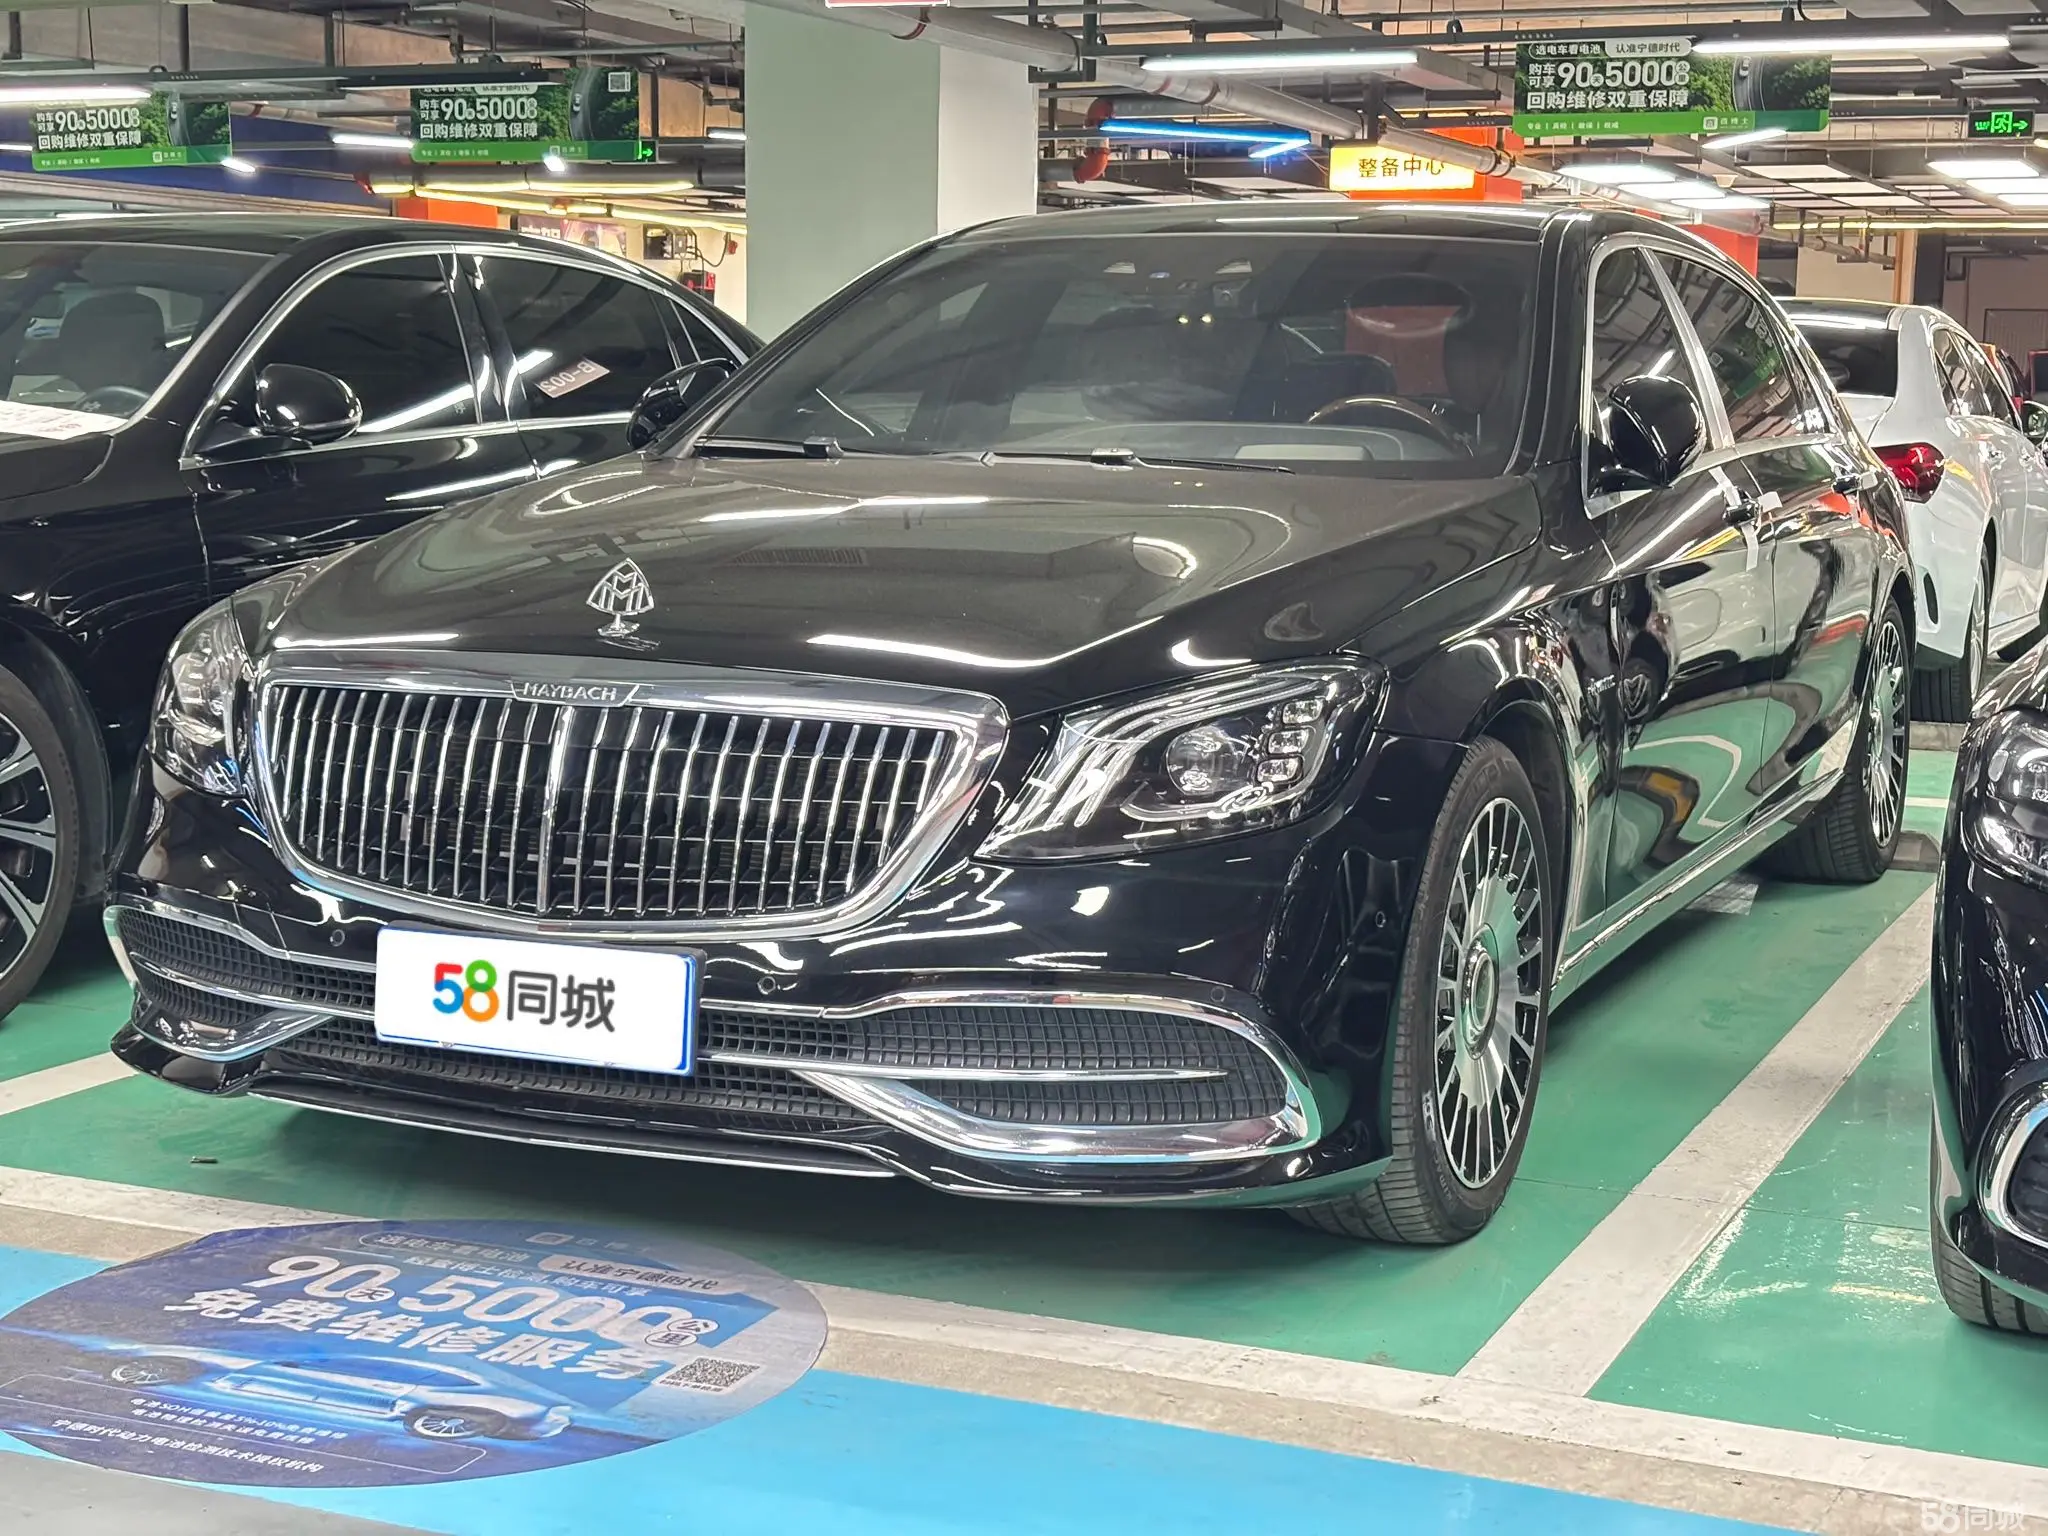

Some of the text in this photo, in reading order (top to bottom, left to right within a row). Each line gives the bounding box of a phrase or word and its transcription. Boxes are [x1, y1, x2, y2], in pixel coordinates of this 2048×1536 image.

[1616, 41, 1681, 54] 认准宁德时代
[1526, 88, 1689, 110] 回购维修双重保障
[38, 130, 142, 150] 回购维修双重保障
[419, 122, 538, 139] 回购维修双重保障
[1358, 154, 1445, 178] 整备中心
[522, 682, 617, 700] MAYBACH
[560, 1258, 721, 1291] 认准宁德时代
[164, 1288, 670, 1380] 免费维修服务
